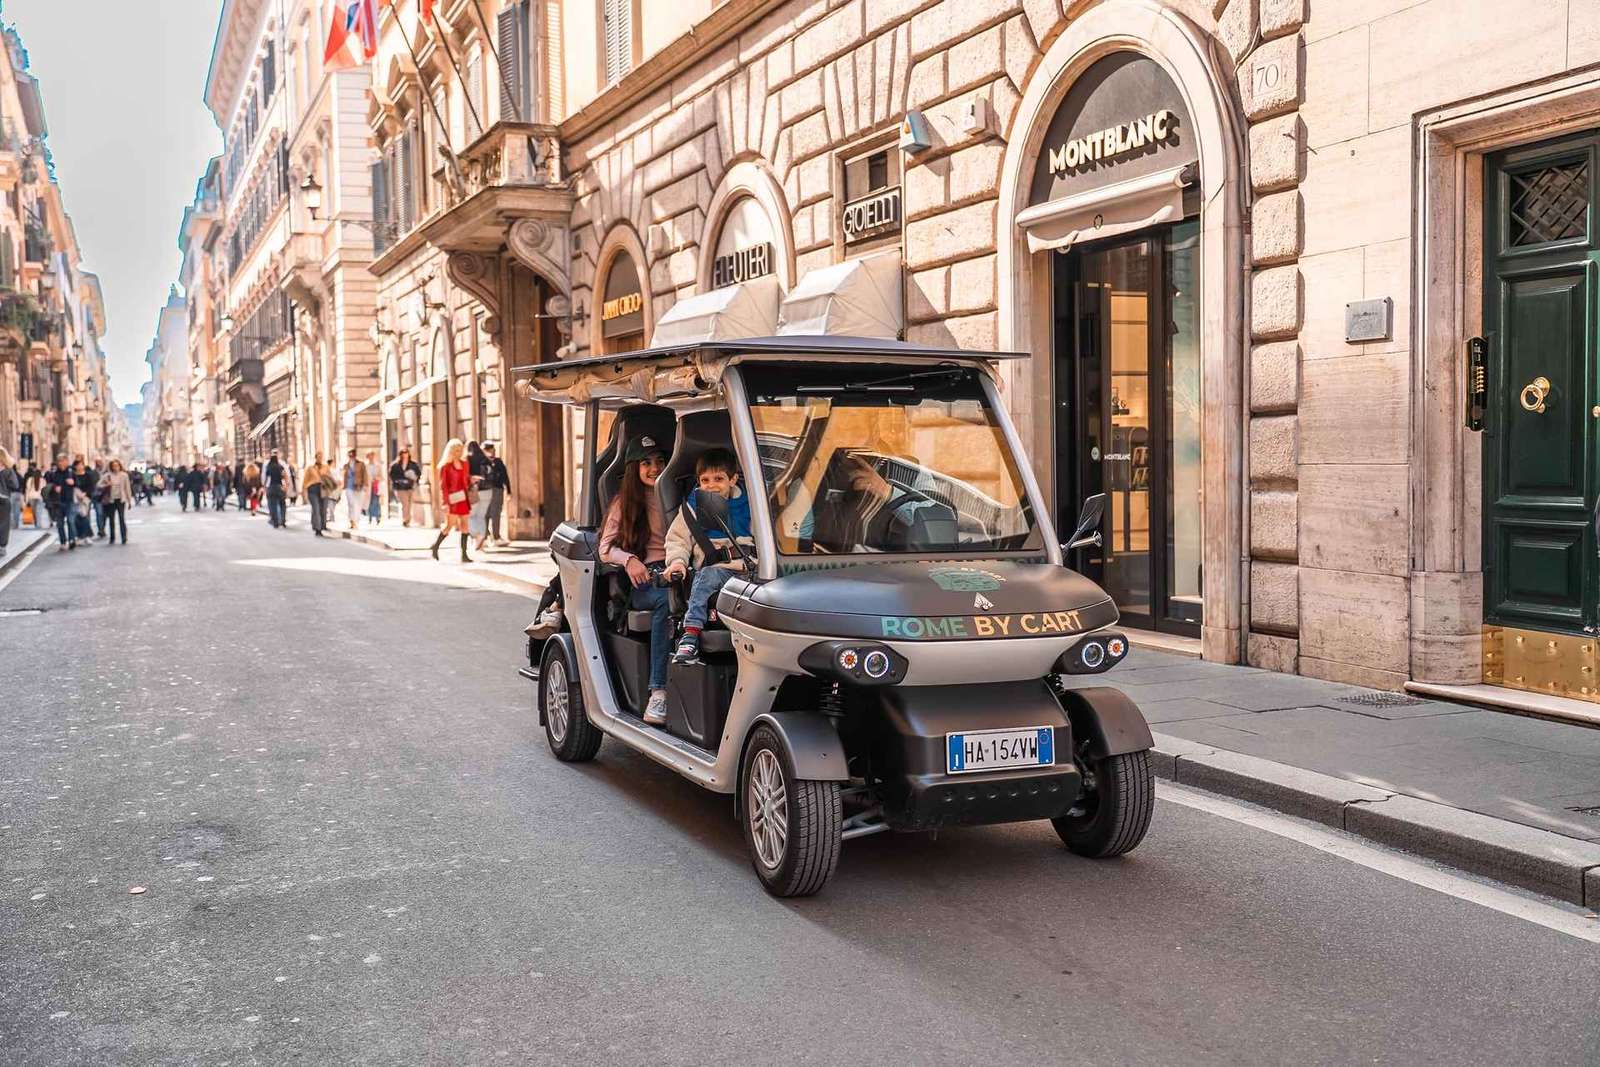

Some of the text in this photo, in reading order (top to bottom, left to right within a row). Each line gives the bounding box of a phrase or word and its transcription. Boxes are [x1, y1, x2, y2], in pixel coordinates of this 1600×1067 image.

[1256, 63, 1279, 92] 70
[1049, 109, 1168, 174] MONTBLANC
[842, 194, 894, 235] GIOIELLI
[880, 610, 1083, 638] ROME BY CART
